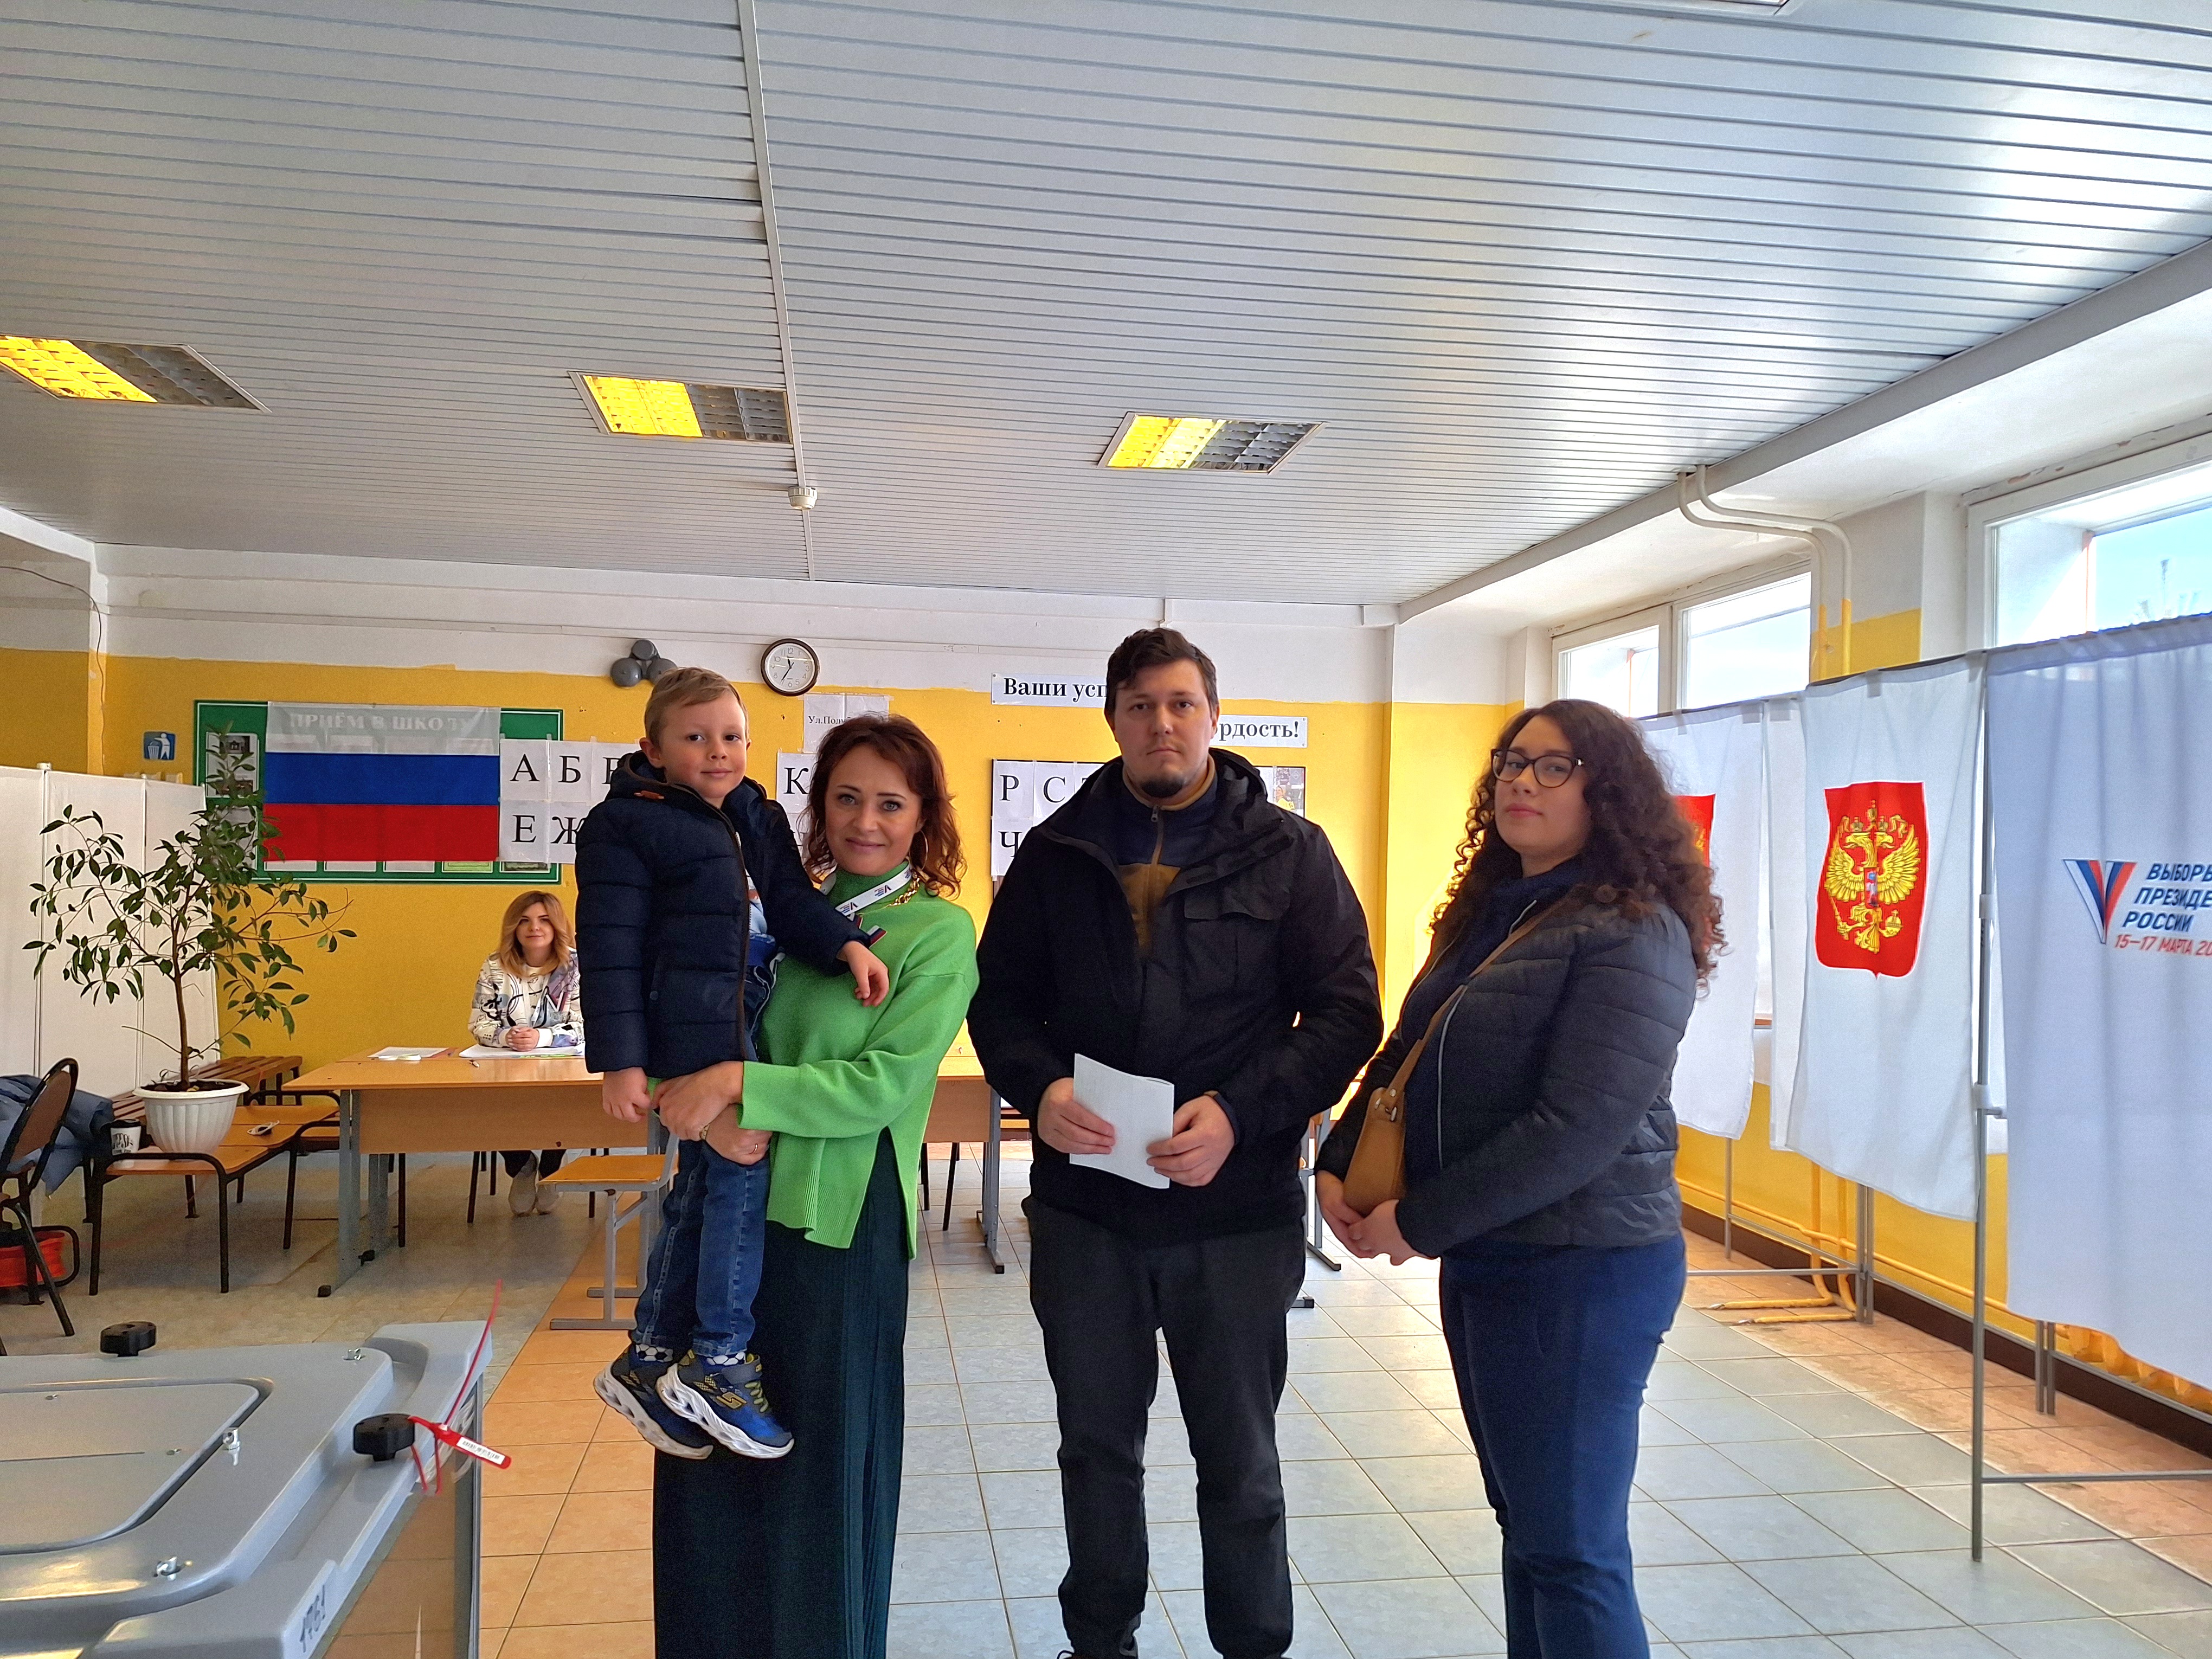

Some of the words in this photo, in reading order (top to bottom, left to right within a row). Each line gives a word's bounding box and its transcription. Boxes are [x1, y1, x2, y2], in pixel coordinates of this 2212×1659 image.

[1003, 677, 1067, 697] Ваши
[808, 716, 851, 724] Ул.Полу
[509, 754, 541, 782] А
[558, 755, 581, 783] Б
[783, 767, 809, 795] К
[999, 775, 1019, 801] Р
[1043, 776, 1066, 803] С
[511, 814, 537, 843] Е
[550, 815, 587, 845] Ж
[998, 831, 1023, 858] Ч
[2133, 886, 2212, 910] ПРЕЗИДЕ
[2121, 910, 2195, 932] РОССИИ
